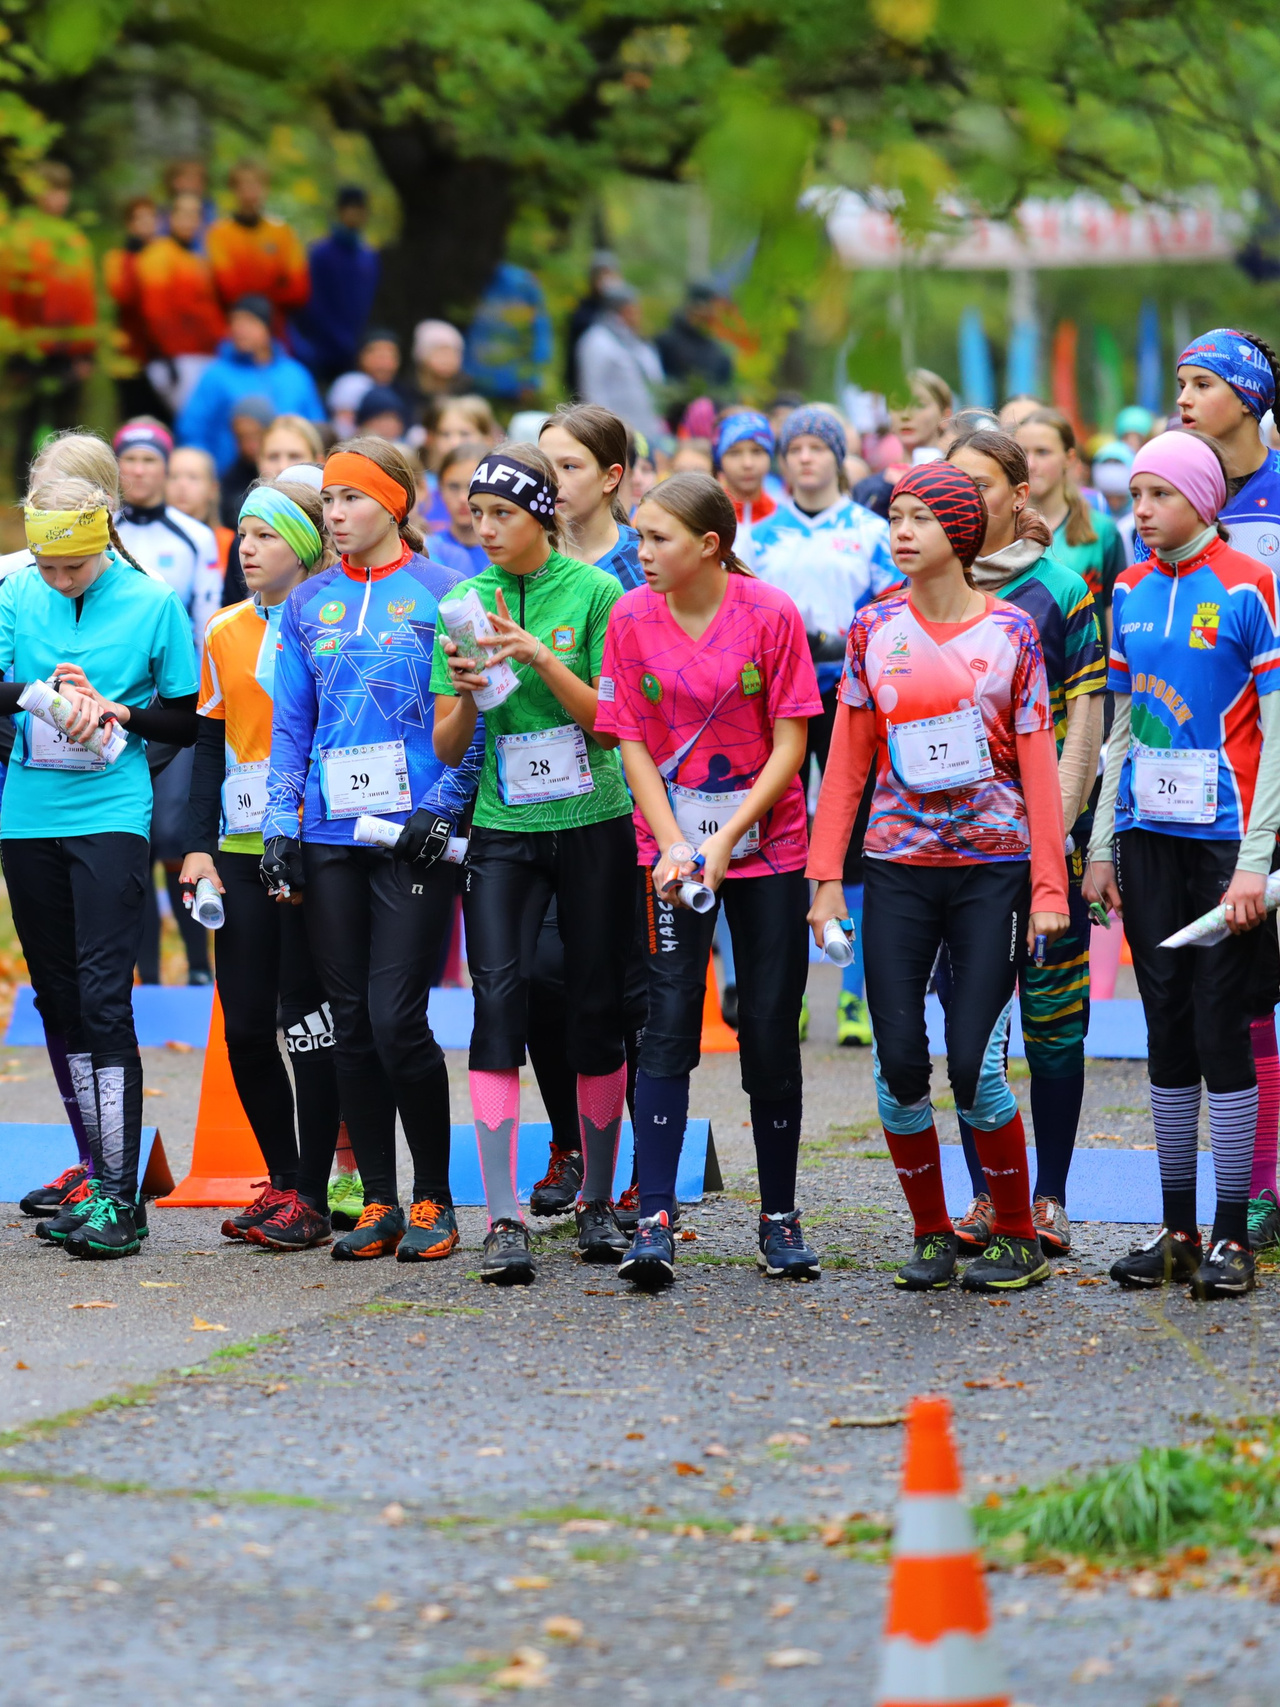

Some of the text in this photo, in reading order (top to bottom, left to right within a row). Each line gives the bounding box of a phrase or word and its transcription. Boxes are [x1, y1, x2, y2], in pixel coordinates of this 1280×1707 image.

[1142, 622, 1154, 632] 18
[319, 640, 334, 651] SFR
[928, 743, 948, 761] 27
[528, 759, 550, 776] 28
[350, 773, 370, 791] 29
[1157, 778, 1178, 794] 26
[237, 792, 252, 810] 30
[698, 819, 718, 836] 40
